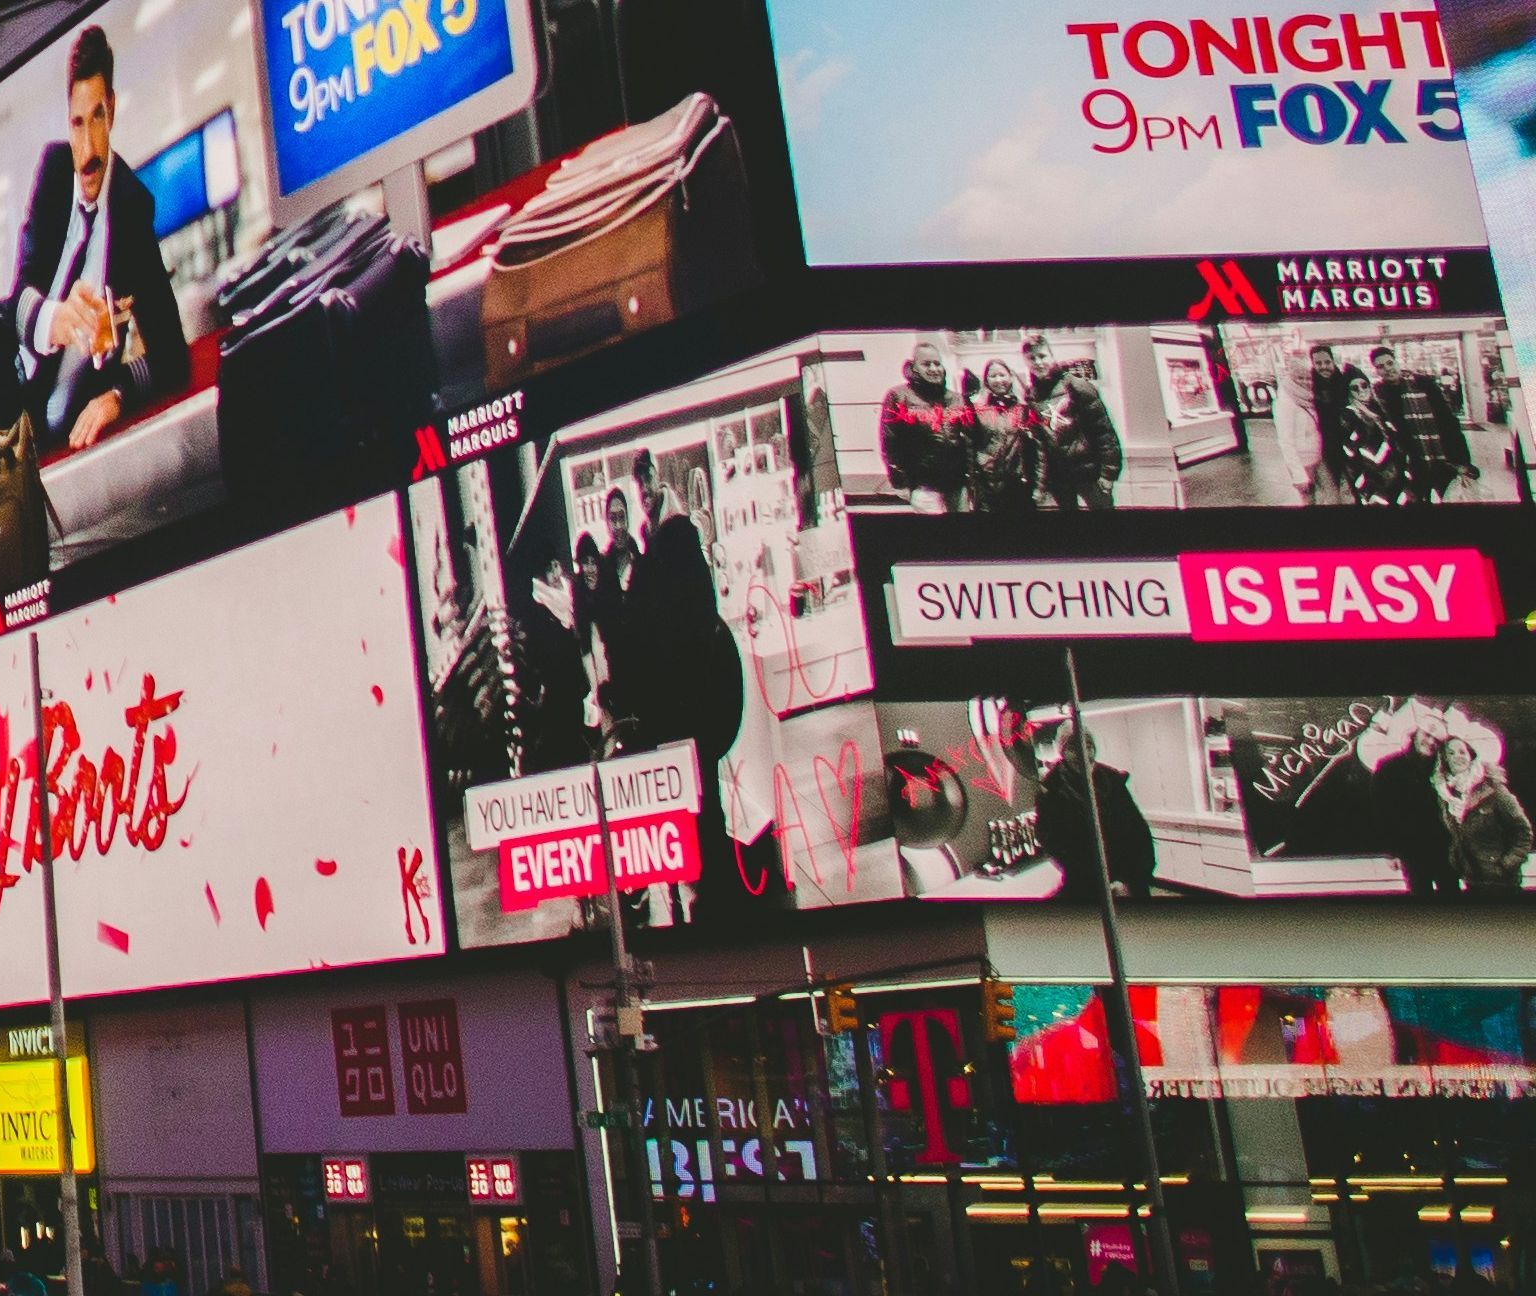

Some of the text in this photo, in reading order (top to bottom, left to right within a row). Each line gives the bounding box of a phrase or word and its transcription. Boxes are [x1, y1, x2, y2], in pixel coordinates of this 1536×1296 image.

[287, 65, 353, 134] 9PM
[351, 1, 444, 95] FOX
[1066, 12, 1450, 80] TONIGHT
[1079, 79, 1467, 155] 9PM FOX 5
[1275, 257, 1448, 284] MARRIOTT
[1281, 285, 1434, 311] MARQUIS
[446, 390, 525, 435] MARRIOTT
[448, 417, 520, 460] MARQUIS
[916, 562, 1458, 628] SWITCHING IS EASY
[27, 671, 201, 872] Boots
[477, 762, 683, 832] YOU HAVE UNLIMITED
[406, 1015, 450, 1054] UNI
[412, 1061, 458, 1107] QLO
